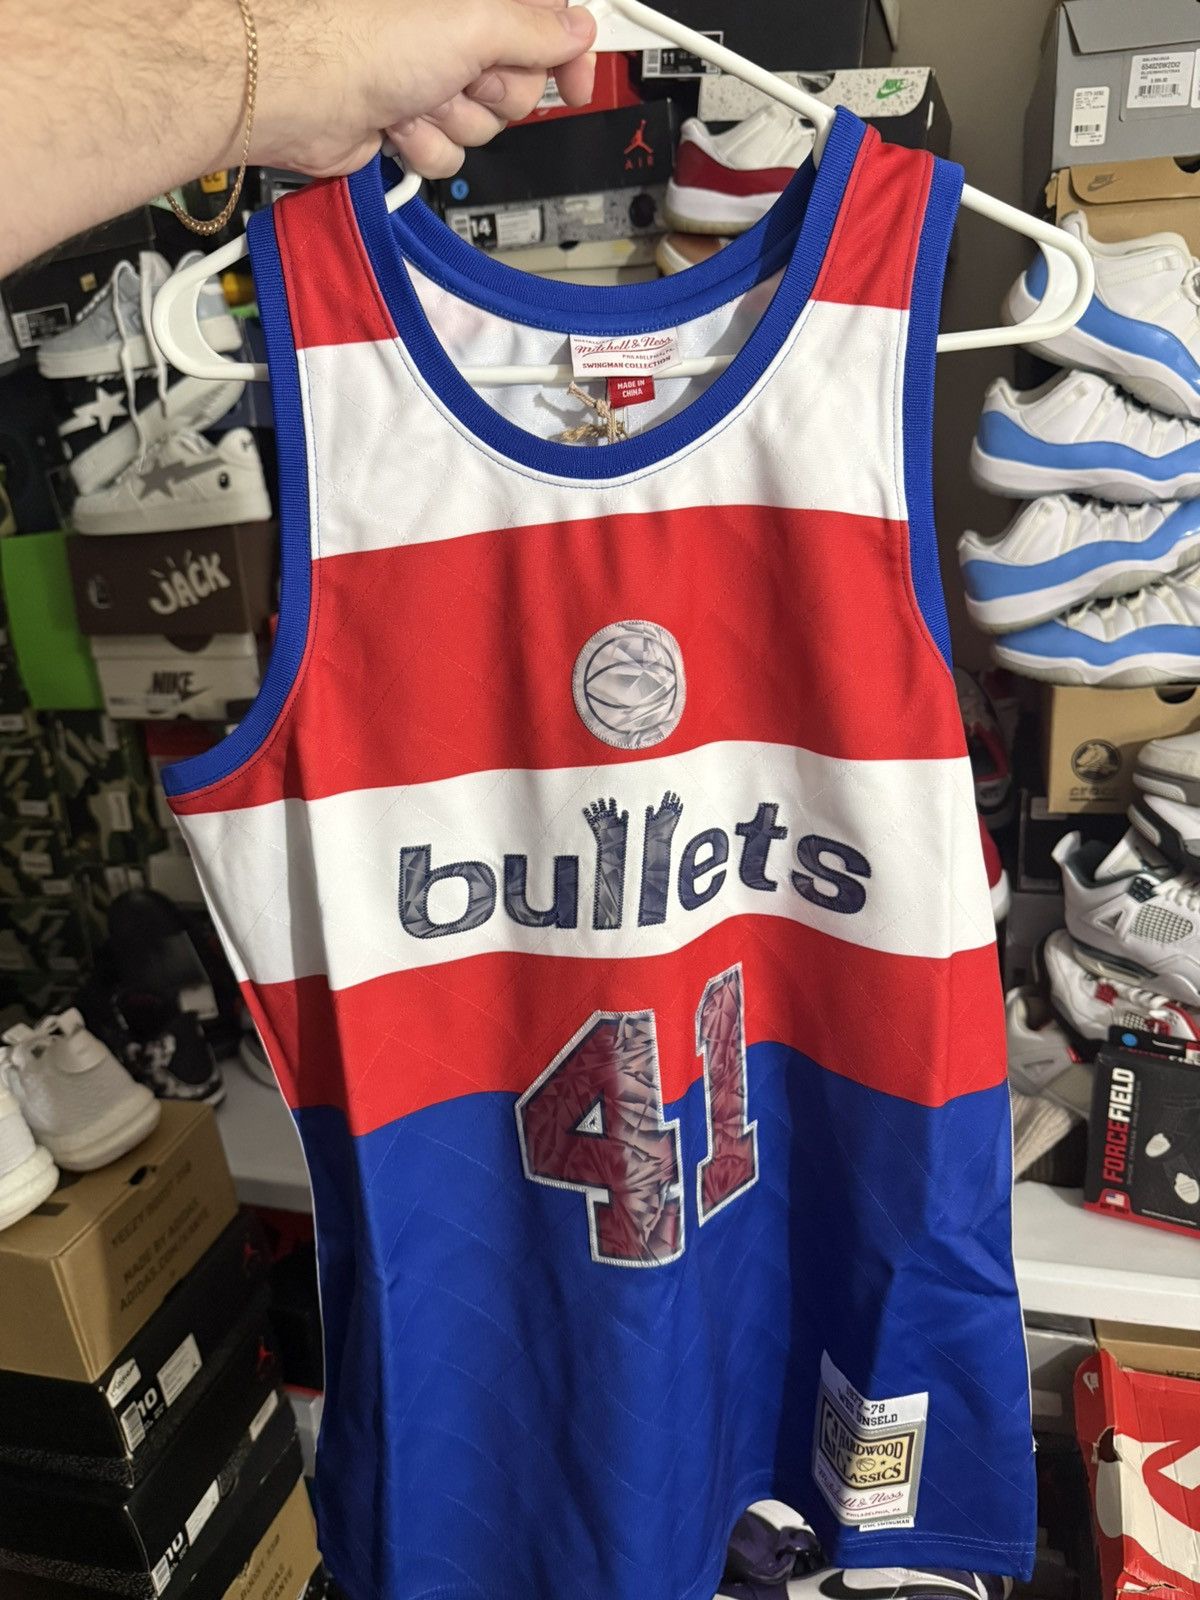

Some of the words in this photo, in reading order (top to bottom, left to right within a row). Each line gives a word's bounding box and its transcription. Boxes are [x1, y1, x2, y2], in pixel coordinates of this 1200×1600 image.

[663, 52, 675, 65] 11
[624, 155, 654, 170] AIR
[470, 218, 492, 237] 14
[575, 339, 630, 353] Mitchell
[631, 339, 640, 348] &
[640, 336, 673, 347] Ness
[582, 361, 624, 369] SWINGMAN
[624, 355, 671, 369] COLLECTION
[617, 381, 637, 390] MADE
[637, 379, 645, 387] IN
[622, 387, 643, 398] CHINA
[149, 552, 231, 615] JACK
[151, 671, 194, 695] NIKE
[399, 790, 873, 940] bullets
[513, 961, 760, 1268] 41
[137, 1387, 158, 1418] 10
[869, 1490, 904, 1504] Ness
[877, 1519, 910, 1527] SWINGMAN
[165, 1531, 184, 1561] 10
